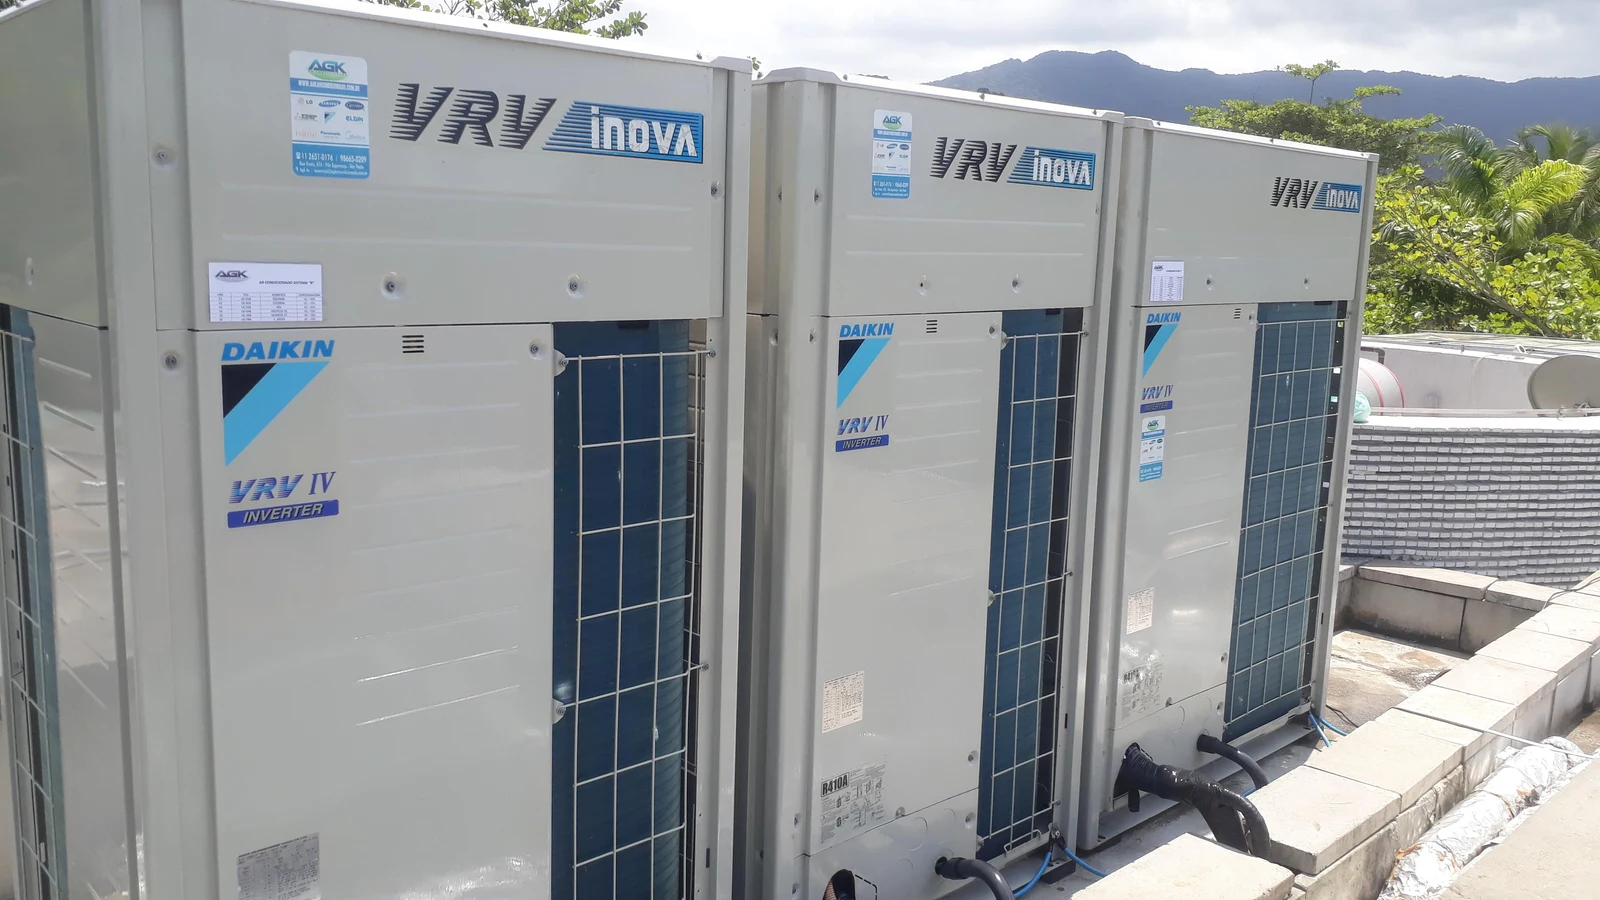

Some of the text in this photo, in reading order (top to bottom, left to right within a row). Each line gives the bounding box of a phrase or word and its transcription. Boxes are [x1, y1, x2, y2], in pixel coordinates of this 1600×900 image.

[308, 59, 347, 74] AGK
[389, 83, 557, 150] VRV
[883, 115, 902, 125] AGK
[929, 137, 1018, 183] VRV
[1270, 176, 1319, 209] VRV
[215, 270, 248, 278] AGK
[1146, 312, 1181, 324] DAIKIN
[839, 322, 895, 338] DAIKIN
[220, 339, 335, 361] DAIKIN
[1141, 384, 1174, 401] VRV IV
[837, 415, 889, 436] VRV IV
[842, 436, 882, 449] INVERTER
[229, 471, 337, 504] VRV IV
[243, 503, 324, 524] INVERTER
[822, 774, 848, 796] R410A
